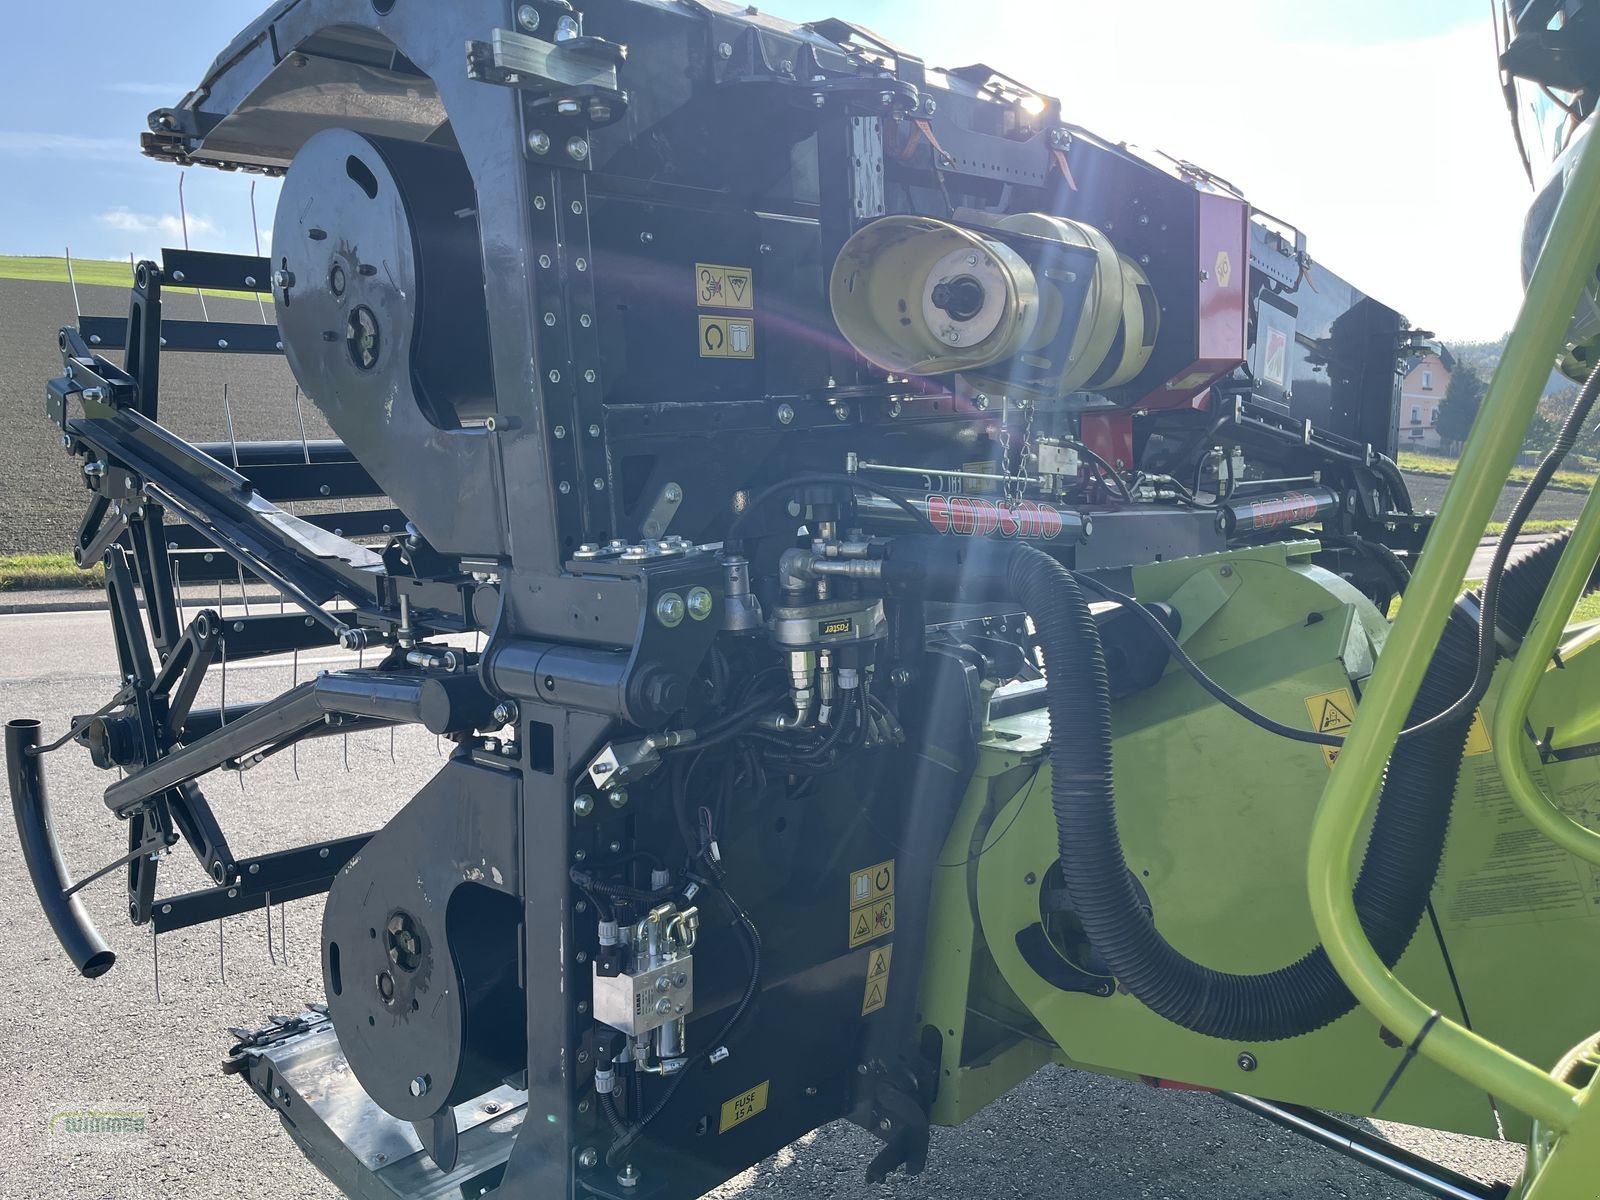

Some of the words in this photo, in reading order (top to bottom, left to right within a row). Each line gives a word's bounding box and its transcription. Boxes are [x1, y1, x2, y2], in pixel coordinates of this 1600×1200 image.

[735, 1092, 755, 1110] FUSE
[735, 1109, 745, 1120] 15
[746, 1104, 753, 1115] A
